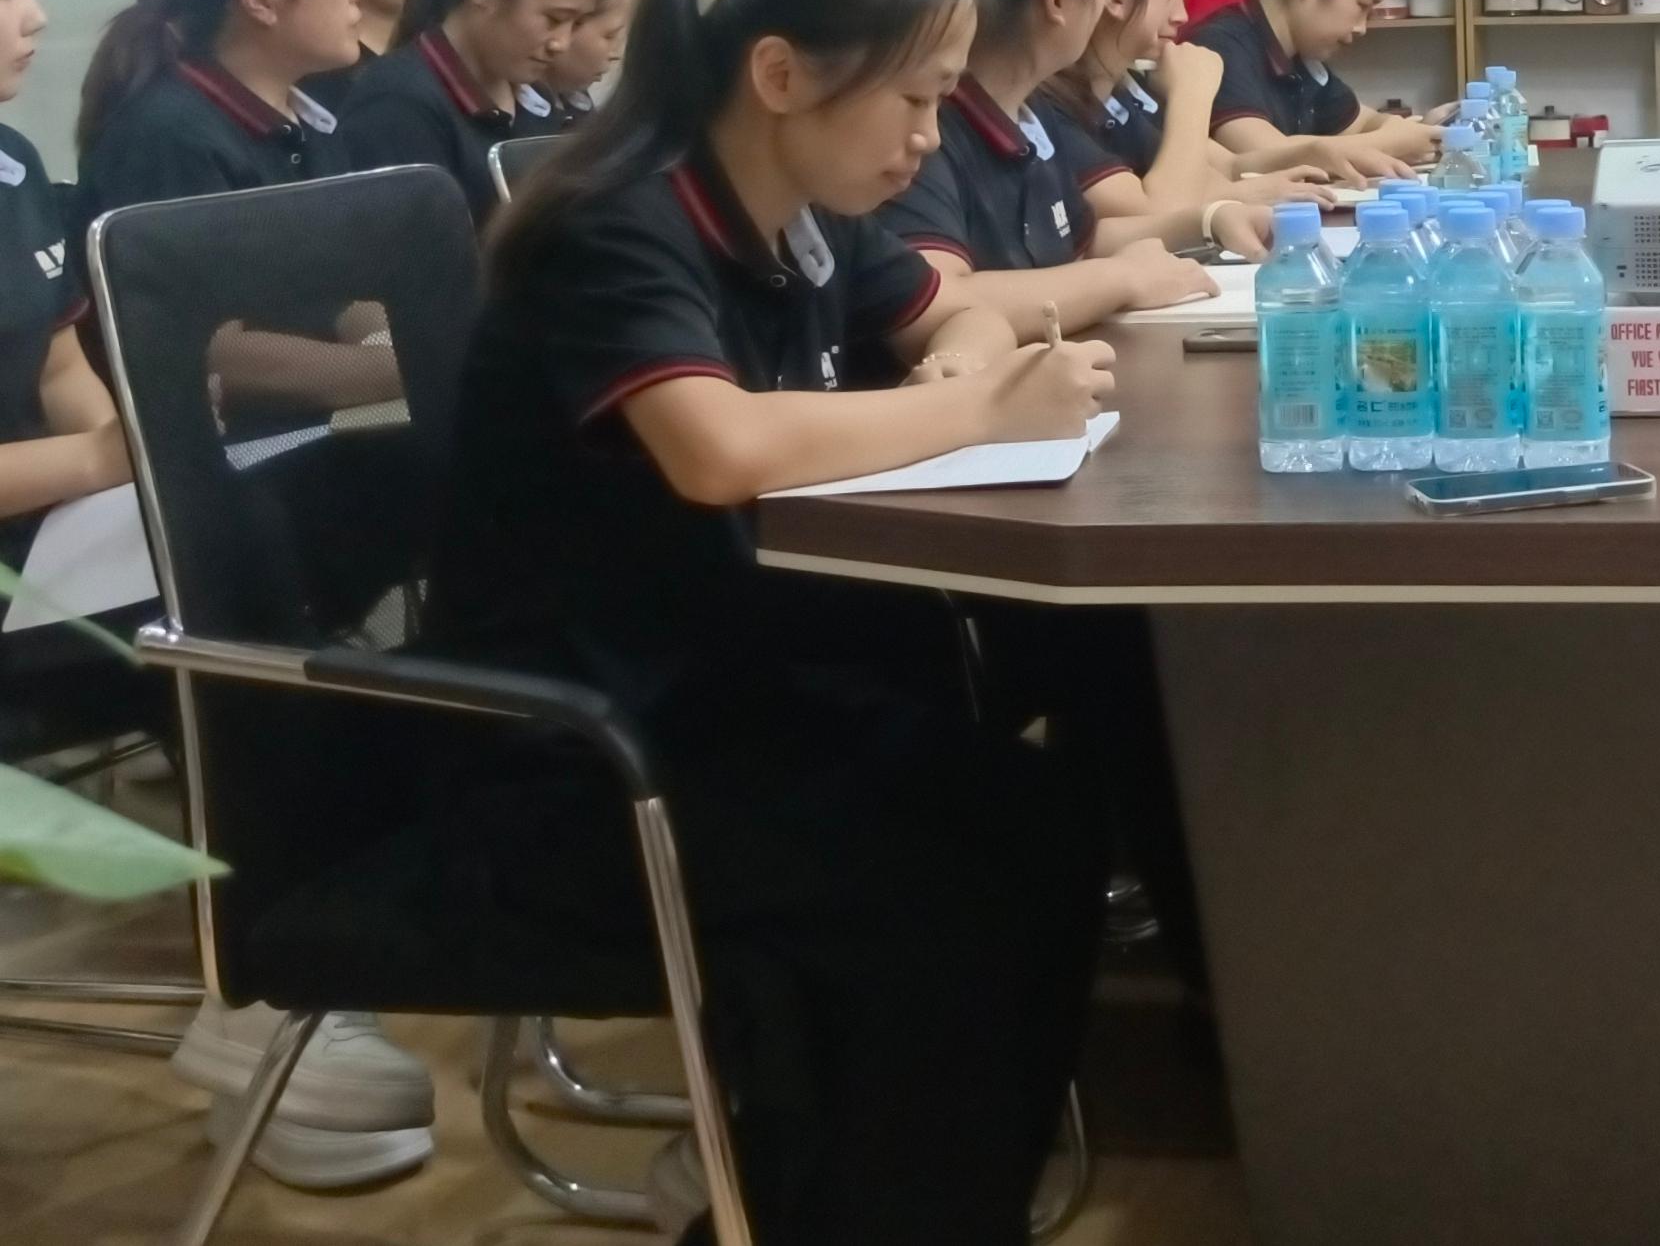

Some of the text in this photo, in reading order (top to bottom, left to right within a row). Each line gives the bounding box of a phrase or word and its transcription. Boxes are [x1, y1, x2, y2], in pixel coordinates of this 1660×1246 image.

[1610, 323, 1652, 340] OFFICE
[1631, 350, 1654, 368] YUE
[1627, 379, 1660, 396] FIRST
